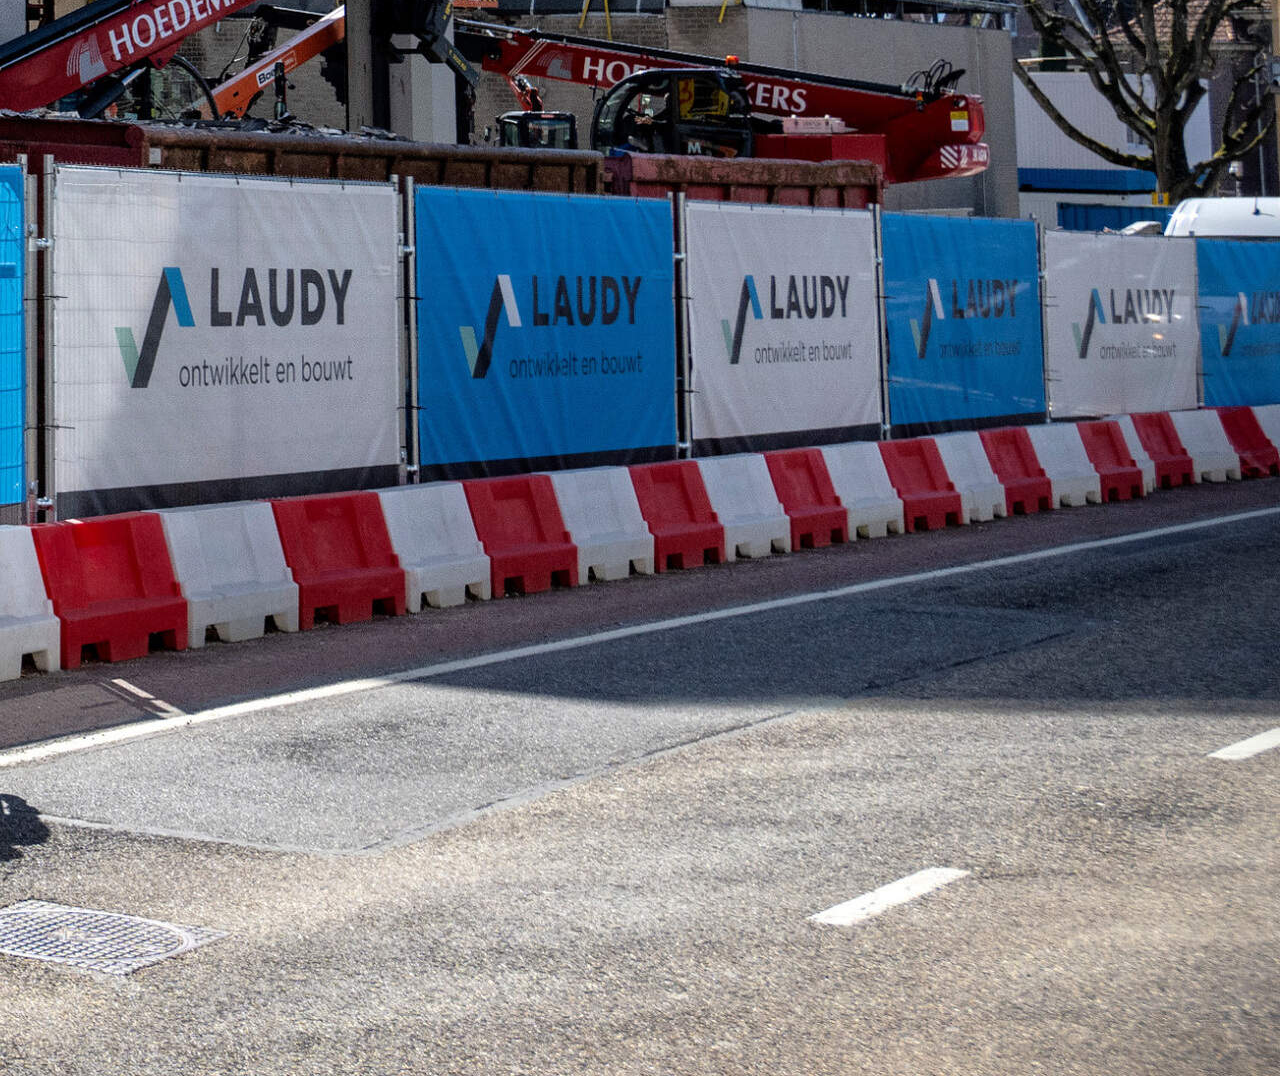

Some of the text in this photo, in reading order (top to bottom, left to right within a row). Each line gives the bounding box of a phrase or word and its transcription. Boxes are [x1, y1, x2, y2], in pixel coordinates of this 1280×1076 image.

[210, 267, 353, 327] LAUDY
[532, 275, 643, 326] LAUDY
[770, 274, 850, 320] LAUDY
[951, 279, 1019, 319] LAUDY
[1110, 289, 1175, 324] LAUDY
[509, 349, 644, 379] ontwikkelt en bouwt
[754, 339, 853, 364] ontwikkelt en bouwt
[178, 354, 354, 388] ontwikkelt en bouwt
